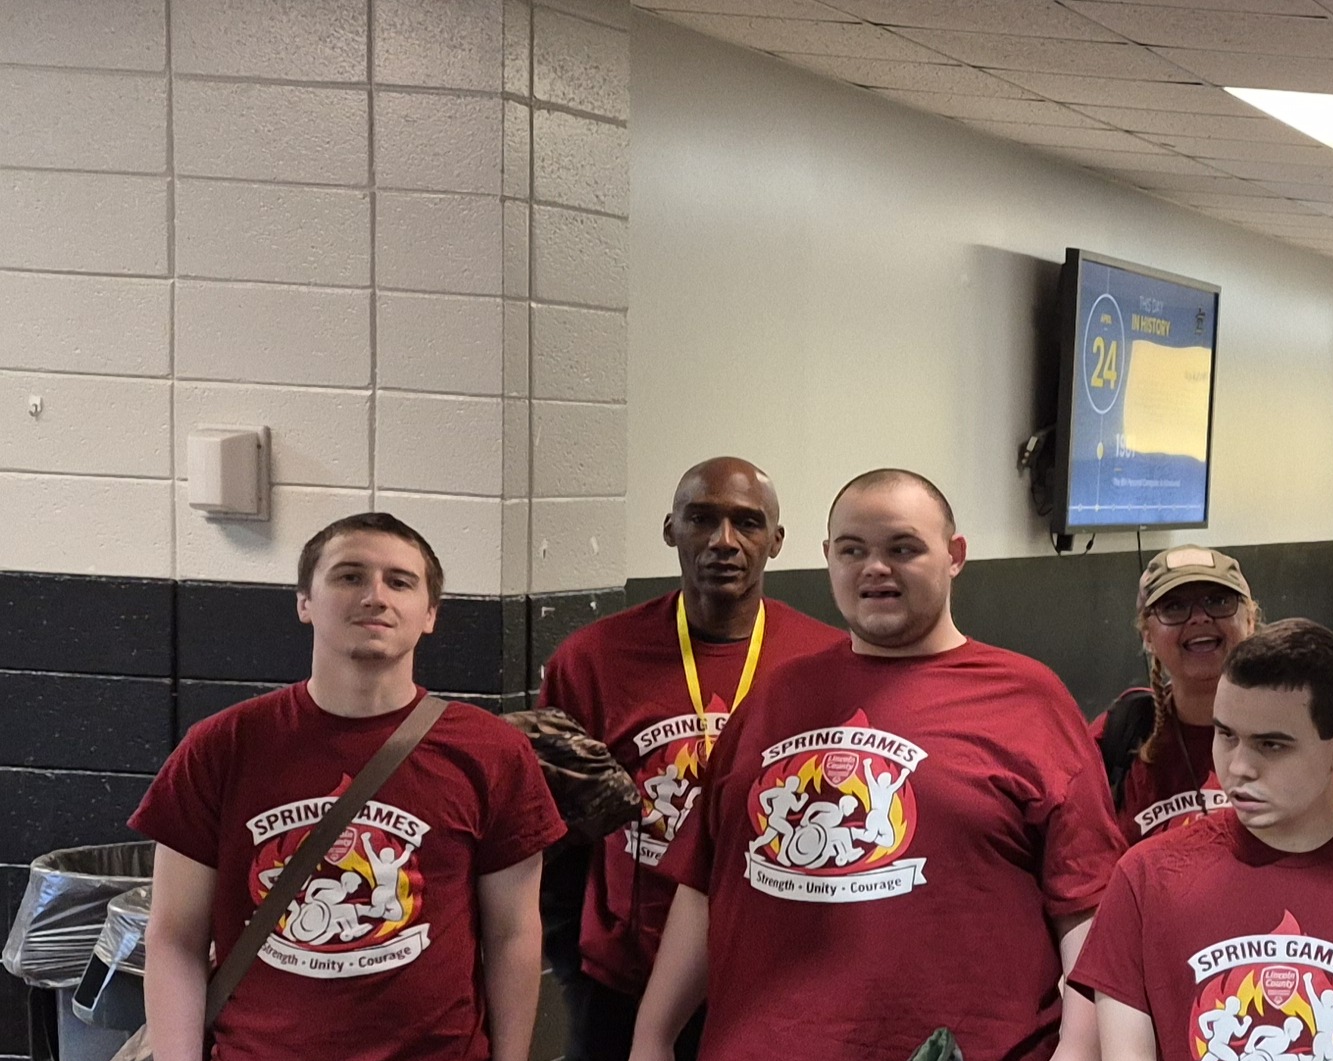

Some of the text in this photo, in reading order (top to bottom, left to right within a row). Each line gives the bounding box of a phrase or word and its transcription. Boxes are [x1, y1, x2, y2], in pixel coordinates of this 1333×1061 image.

[1141, 315, 1171, 337] HISTORY
[1091, 336, 1117, 389] 24
[768, 730, 918, 763] SPRING GAMES
[357, 805, 420, 838] AMES
[756, 870, 902, 896] Strength Unity Courage
[309, 959, 345, 973] Unity
[358, 946, 412, 968] Courage
[1197, 940, 1277, 972] SPRING
[1265, 970, 1295, 980] Lincoln
[1265, 979, 1294, 989] County
